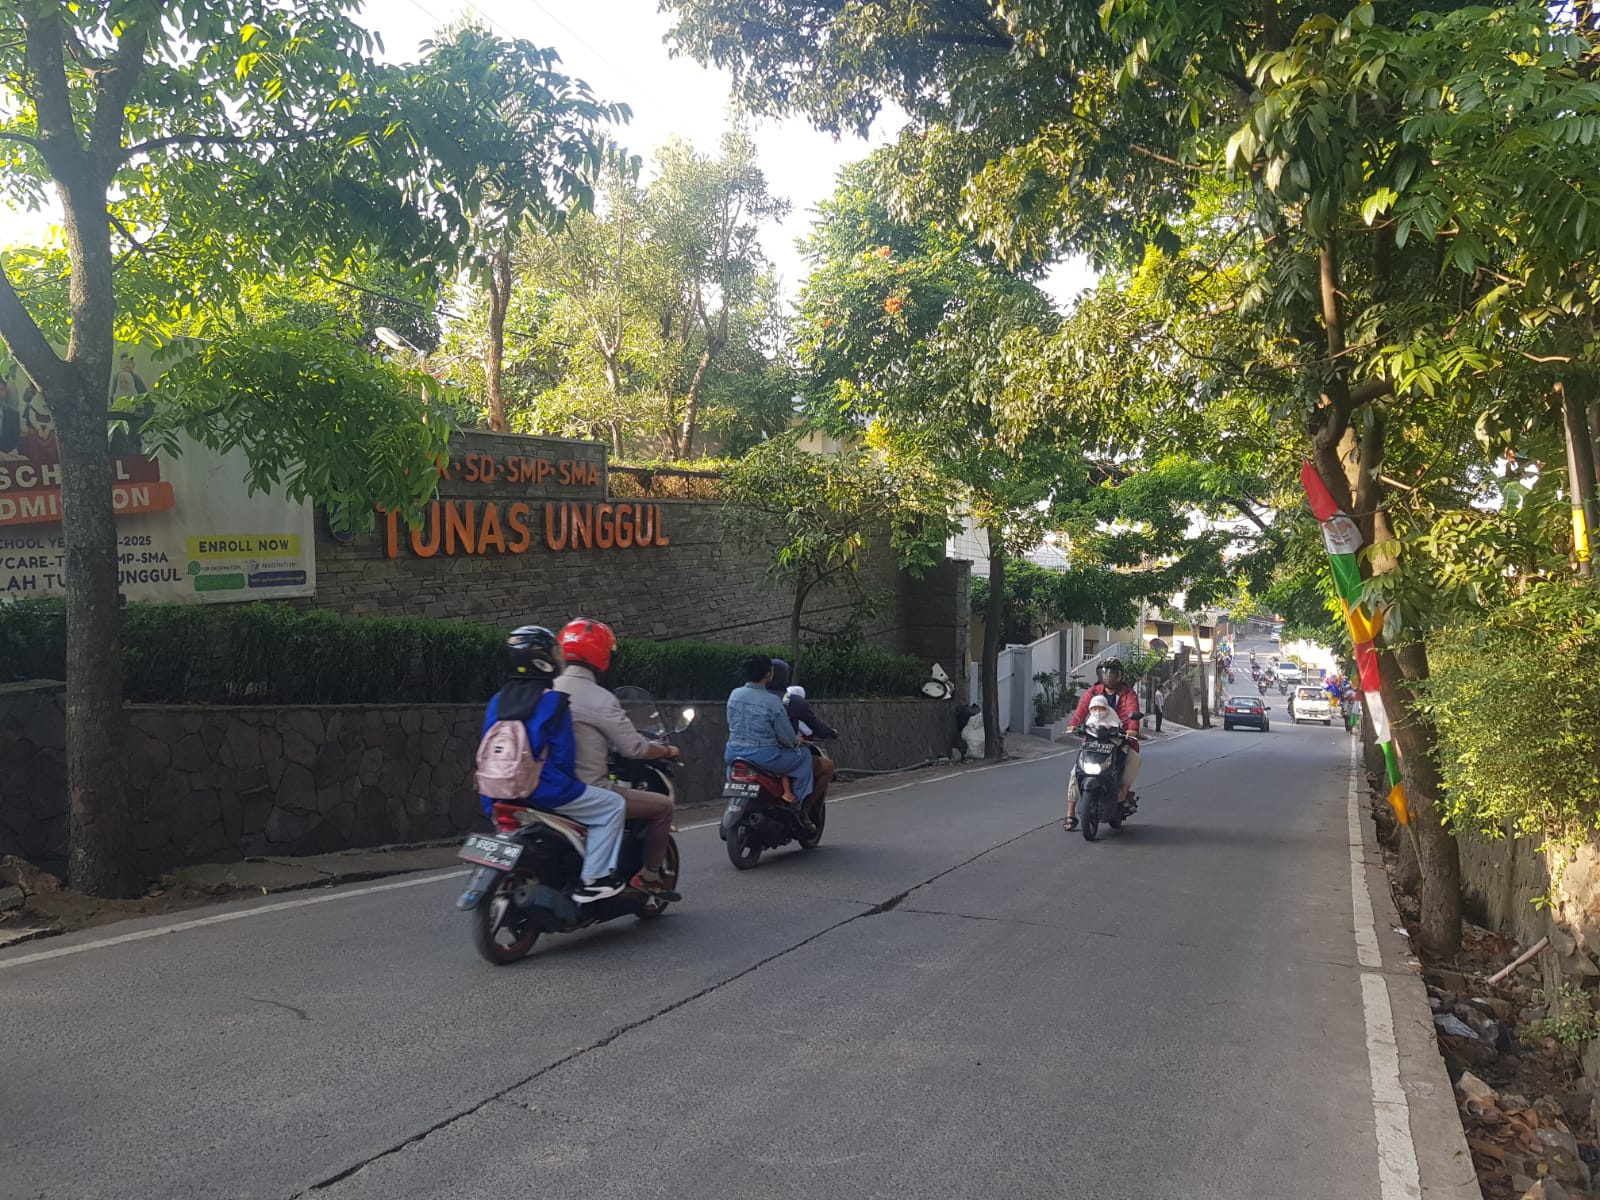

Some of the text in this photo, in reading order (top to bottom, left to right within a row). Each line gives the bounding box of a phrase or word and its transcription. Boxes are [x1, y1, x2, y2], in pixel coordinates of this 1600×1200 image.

[559, 460, 600, 487] SMA
[376, 500, 670, 559] TUNAS UNGGUL
[199, 539, 289, 553] ENROLL NOW
[117, 568, 182, 585] UNGGUL
